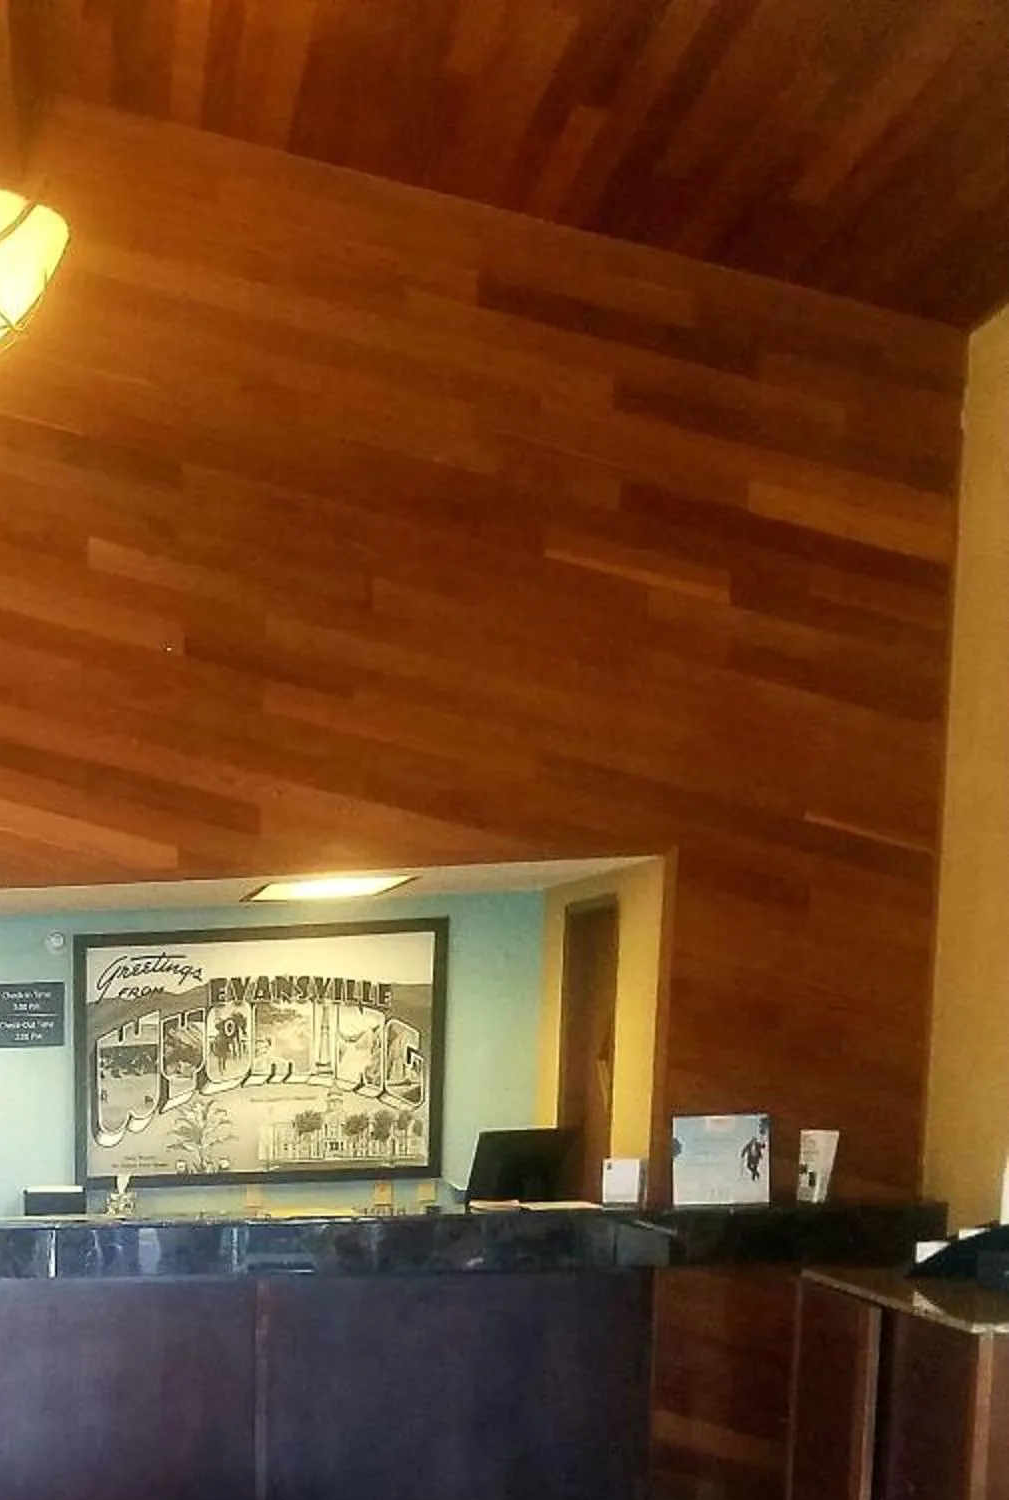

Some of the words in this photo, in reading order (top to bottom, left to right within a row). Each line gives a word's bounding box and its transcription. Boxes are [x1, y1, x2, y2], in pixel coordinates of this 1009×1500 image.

[95, 952, 203, 1004] Greetings
[208, 975, 392, 1005] EVANSVILLE
[92, 1005, 425, 1147] WYOMING
